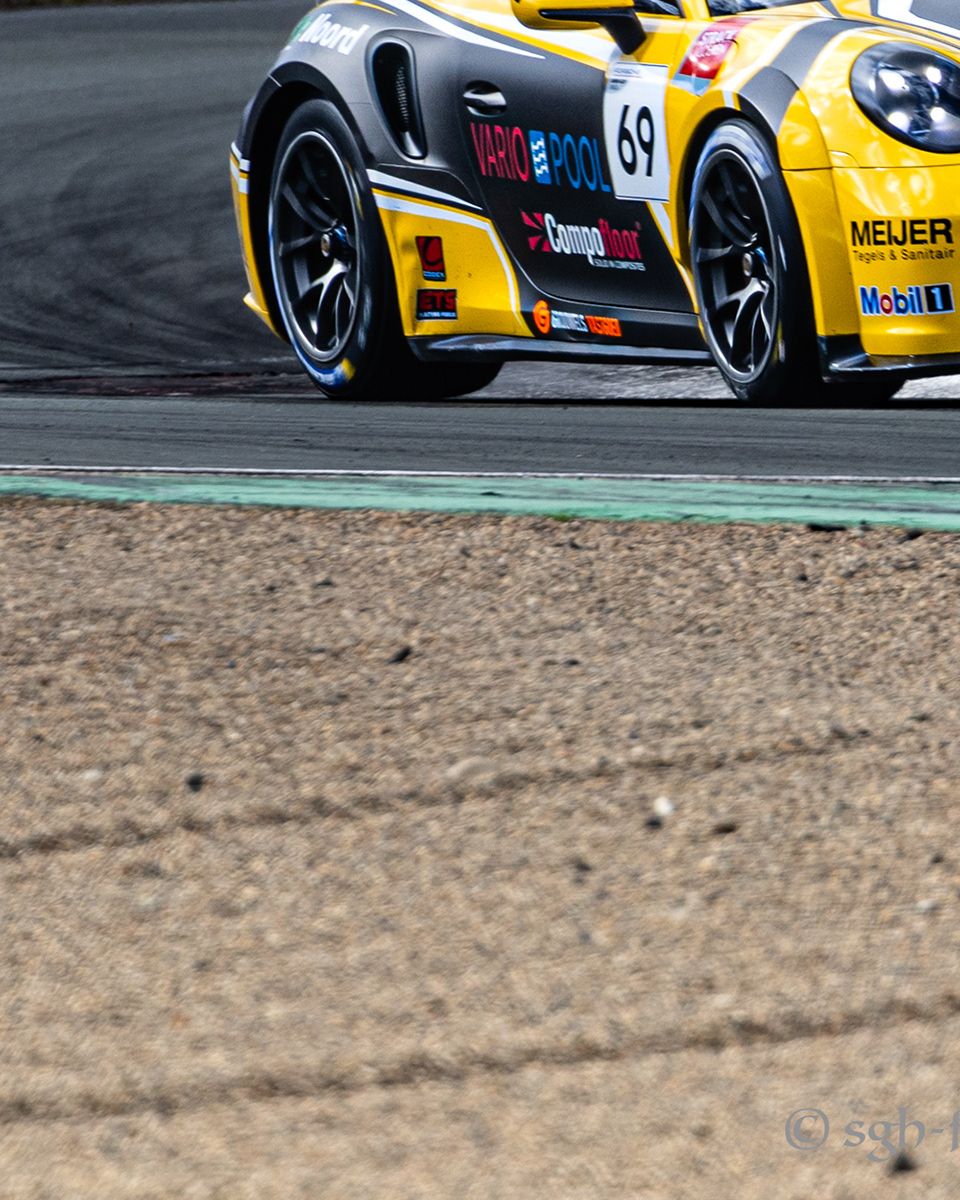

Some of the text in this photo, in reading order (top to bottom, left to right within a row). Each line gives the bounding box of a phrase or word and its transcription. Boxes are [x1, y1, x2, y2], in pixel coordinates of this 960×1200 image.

[617, 104, 655, 178] 69
[470, 121, 612, 193] VARIO POOL
[544, 212, 642, 267] Compofloor
[850, 218, 954, 247] MEIJER
[852, 246, 956, 265] Tegels & Sanitair
[419, 290, 456, 310] ETS
[858, 285, 925, 316] Mobil
